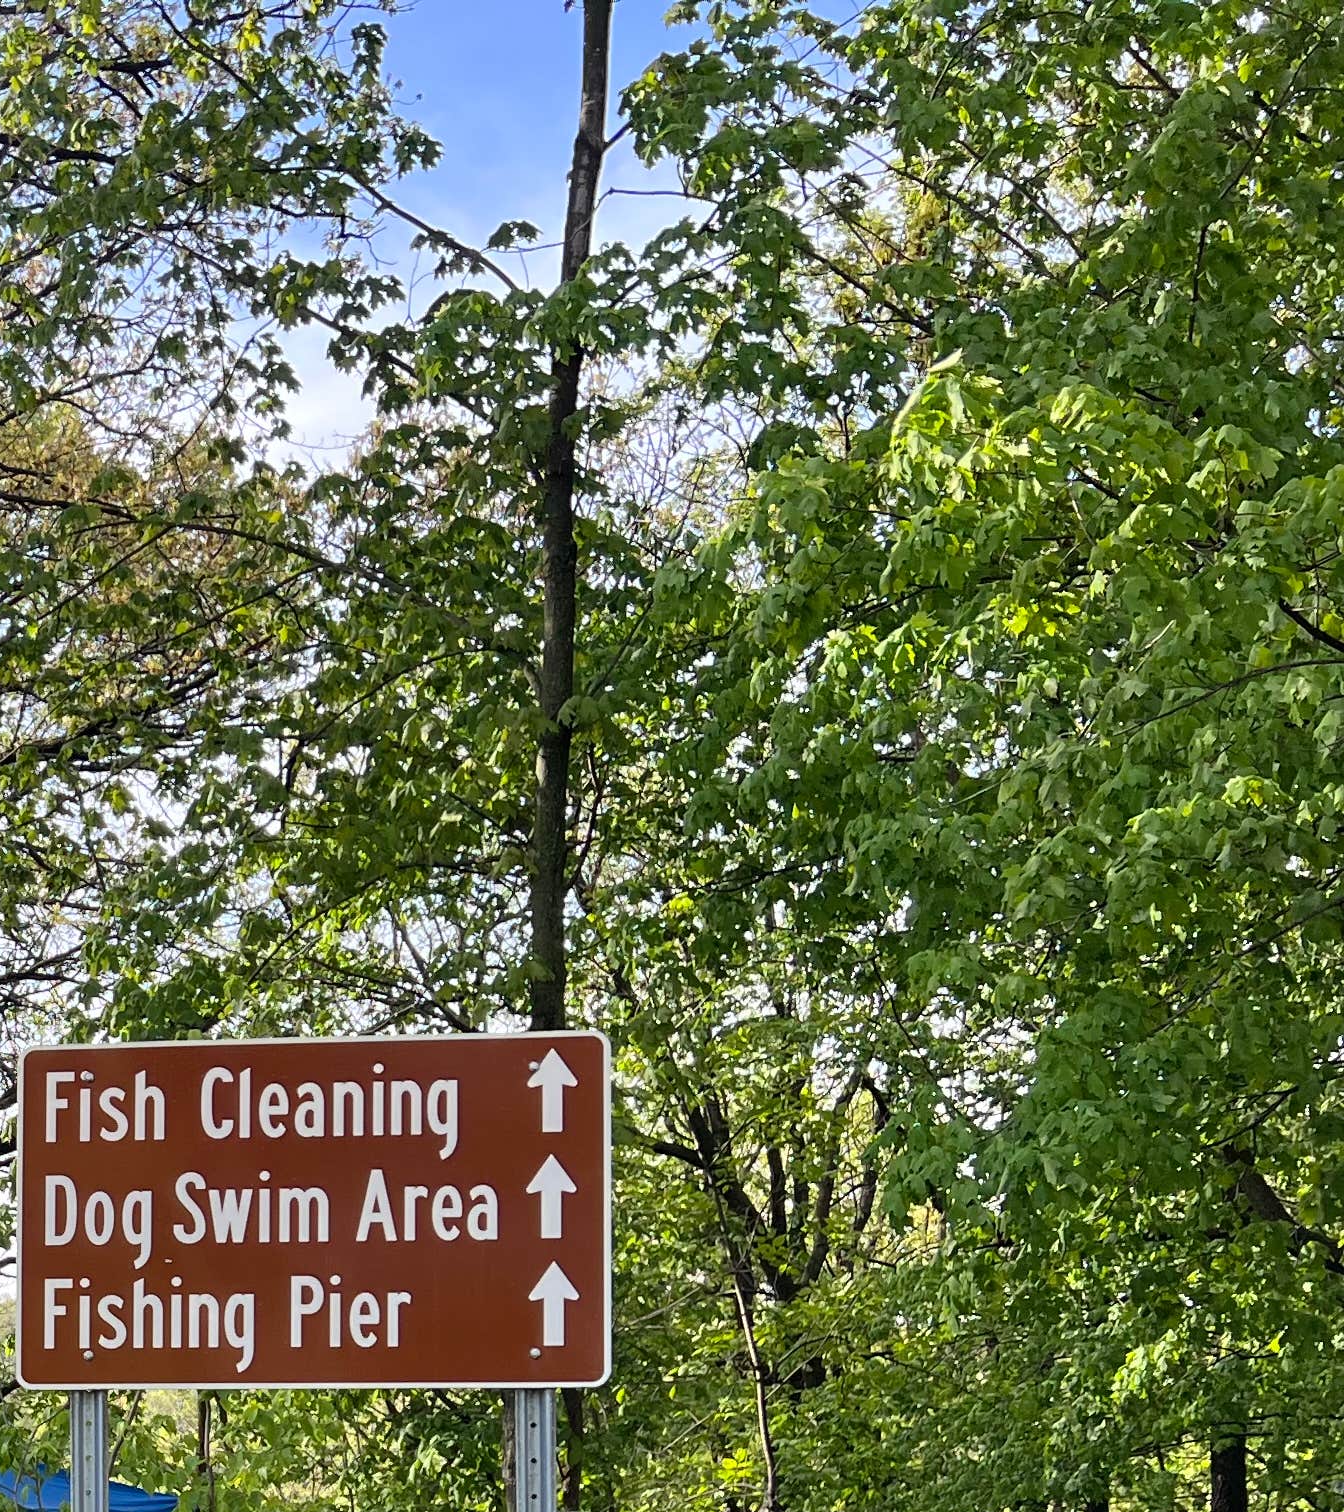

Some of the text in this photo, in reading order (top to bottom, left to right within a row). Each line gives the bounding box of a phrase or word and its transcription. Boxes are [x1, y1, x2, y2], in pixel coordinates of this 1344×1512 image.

[44, 1063, 459, 1161] Fish Cleaning
[44, 1168, 499, 1270] Dog Swim Area
[43, 1274, 413, 1374] Fishing Pier
